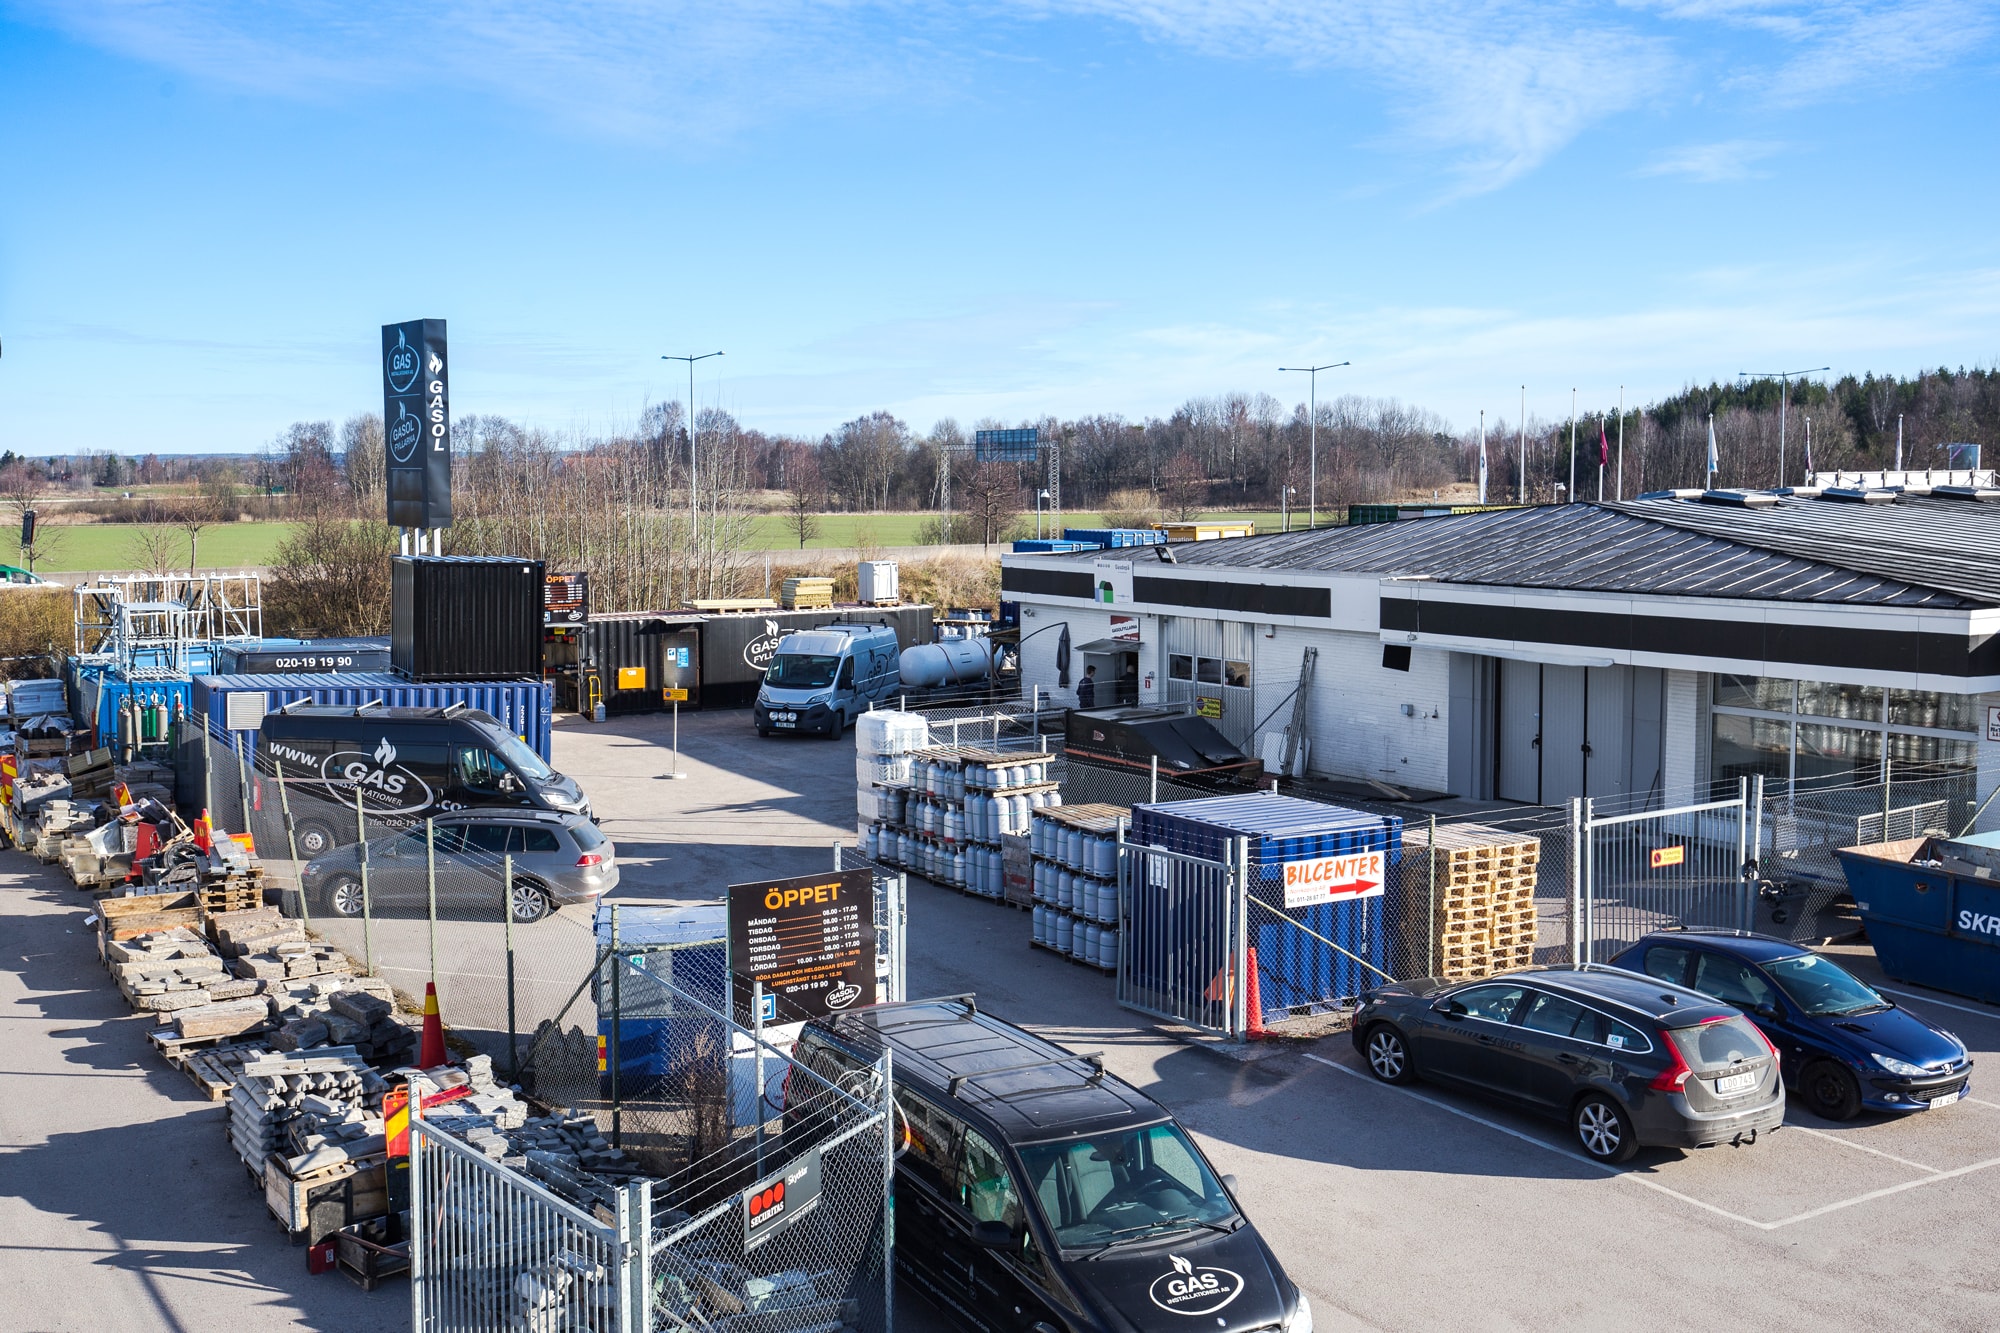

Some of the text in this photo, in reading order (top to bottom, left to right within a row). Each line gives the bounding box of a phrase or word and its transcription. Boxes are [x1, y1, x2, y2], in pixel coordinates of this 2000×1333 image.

[394, 352, 411, 370] GAS
[429, 380, 445, 452] GASOL
[392, 420, 414, 441] GASOL
[546, 575, 576, 583] ÖPPET
[276, 656, 352, 668] 020-19 19 90
[868, 660, 881, 684] GAS
[270, 742, 319, 768] www.
[344, 762, 406, 794] GAS
[335, 780, 403, 806] NSTALATIONER
[435, 800, 468, 812] .co
[1286, 856, 1380, 886] BILCENTER
[764, 883, 842, 910] ÖPPET
[748, 918, 777, 926] MÅNDAG
[748, 927, 772, 935] TISDAG
[749, 936, 776, 944] ONSDAG
[749, 944, 781, 953] TORSDAG
[750, 954, 776, 962] FREDAG
[750, 962, 777, 971] LÖRDAG
[804, 964, 835, 973] HELGDAGAR
[786, 984, 808, 993] 020-19
[830, 987, 854, 1000] GASOL
[1739, 1073, 1752, 1084] 743
[788, 1166, 808, 1186] Skyddar
[750, 1201, 784, 1228] SECURITAS
[1168, 1273, 1218, 1296] GAS
[1167, 1290, 1221, 1304] INSTALLATIONER
